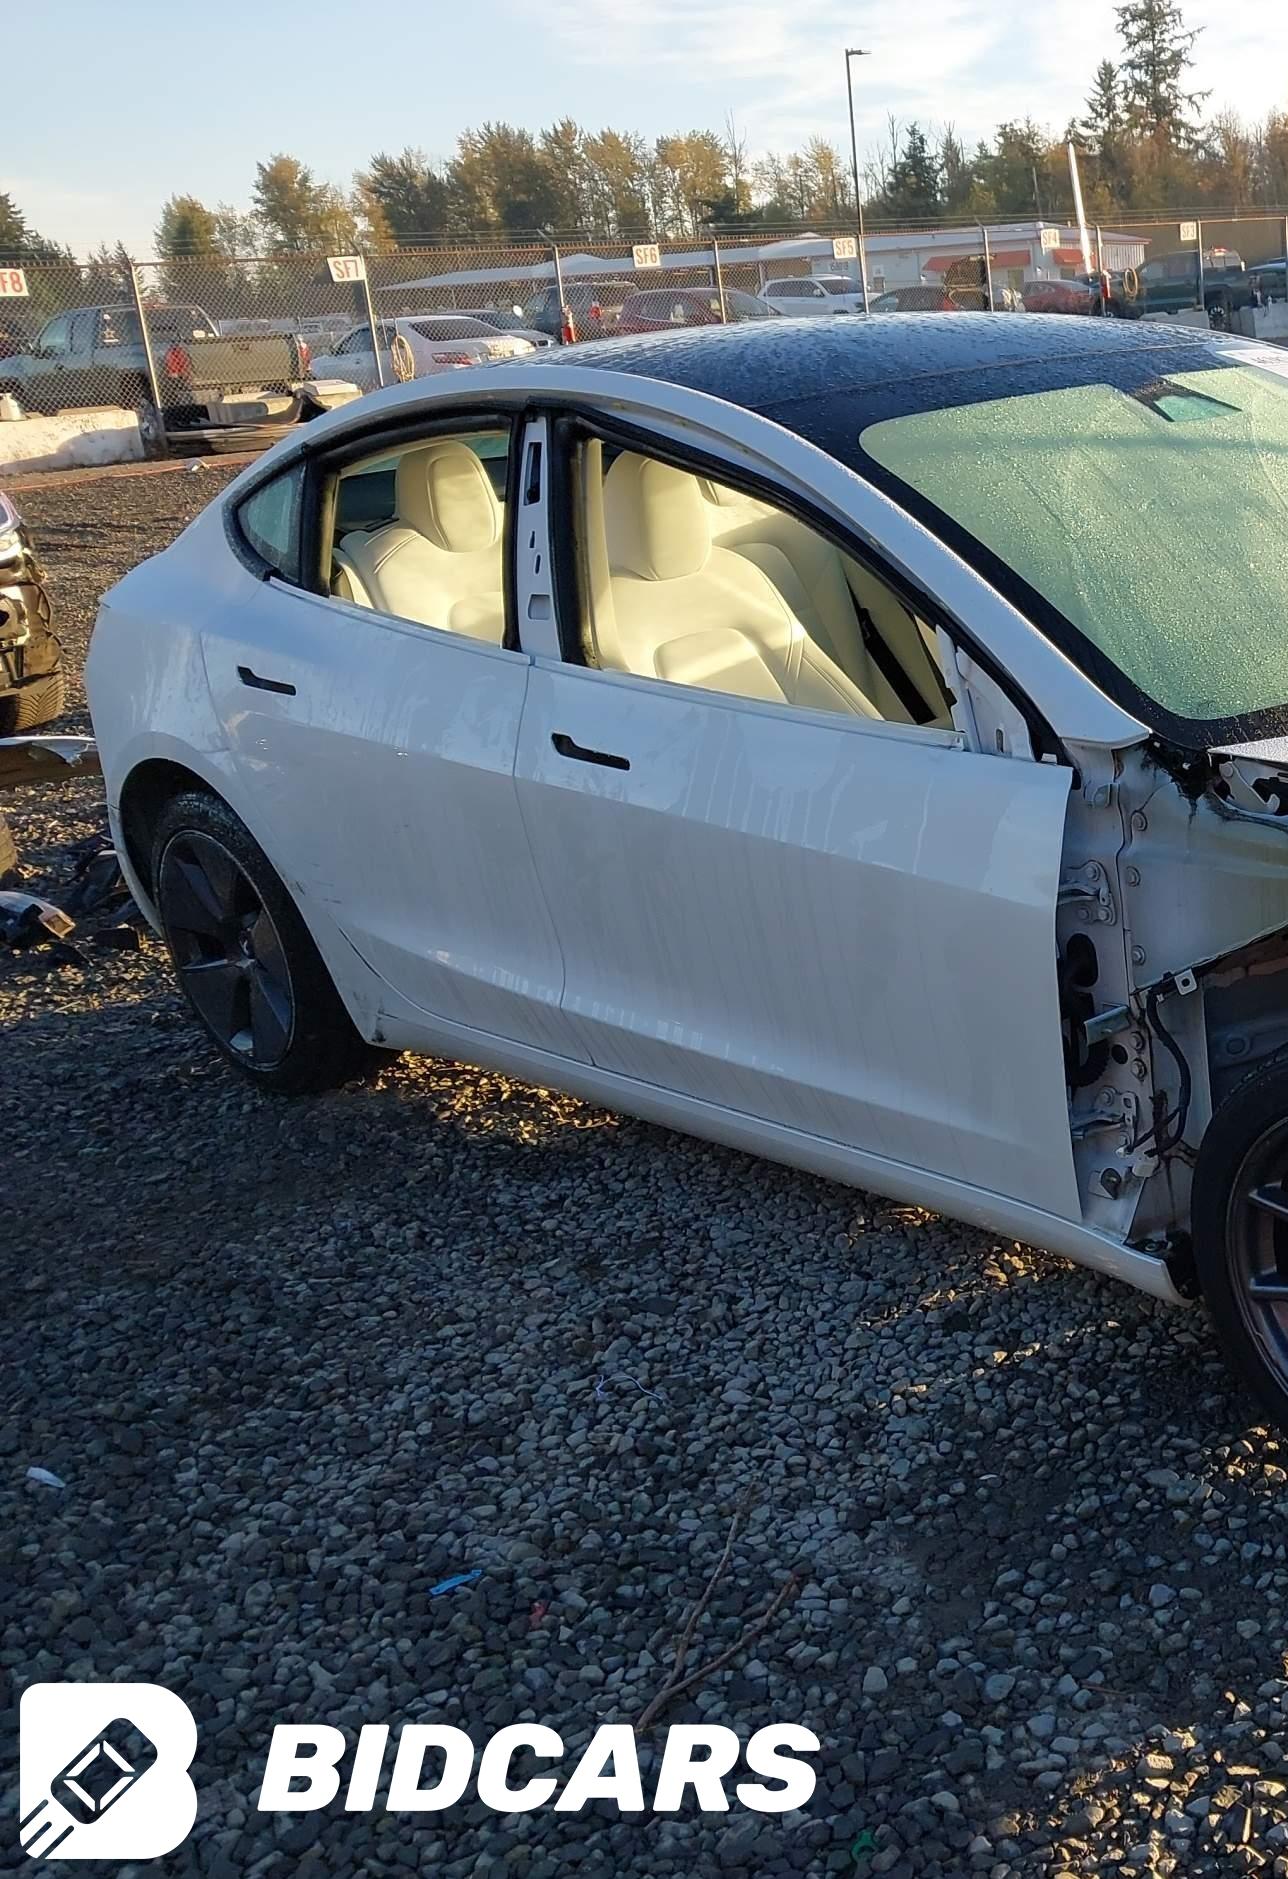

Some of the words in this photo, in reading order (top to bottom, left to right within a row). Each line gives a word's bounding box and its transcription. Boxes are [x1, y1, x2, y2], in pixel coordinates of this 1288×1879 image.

[1043, 230, 1057, 246] SF4
[1183, 223, 1194, 238] SF3
[835, 239, 854, 255] SF5
[635, 248, 657, 265] SF6
[333, 260, 358, 279] SF7
